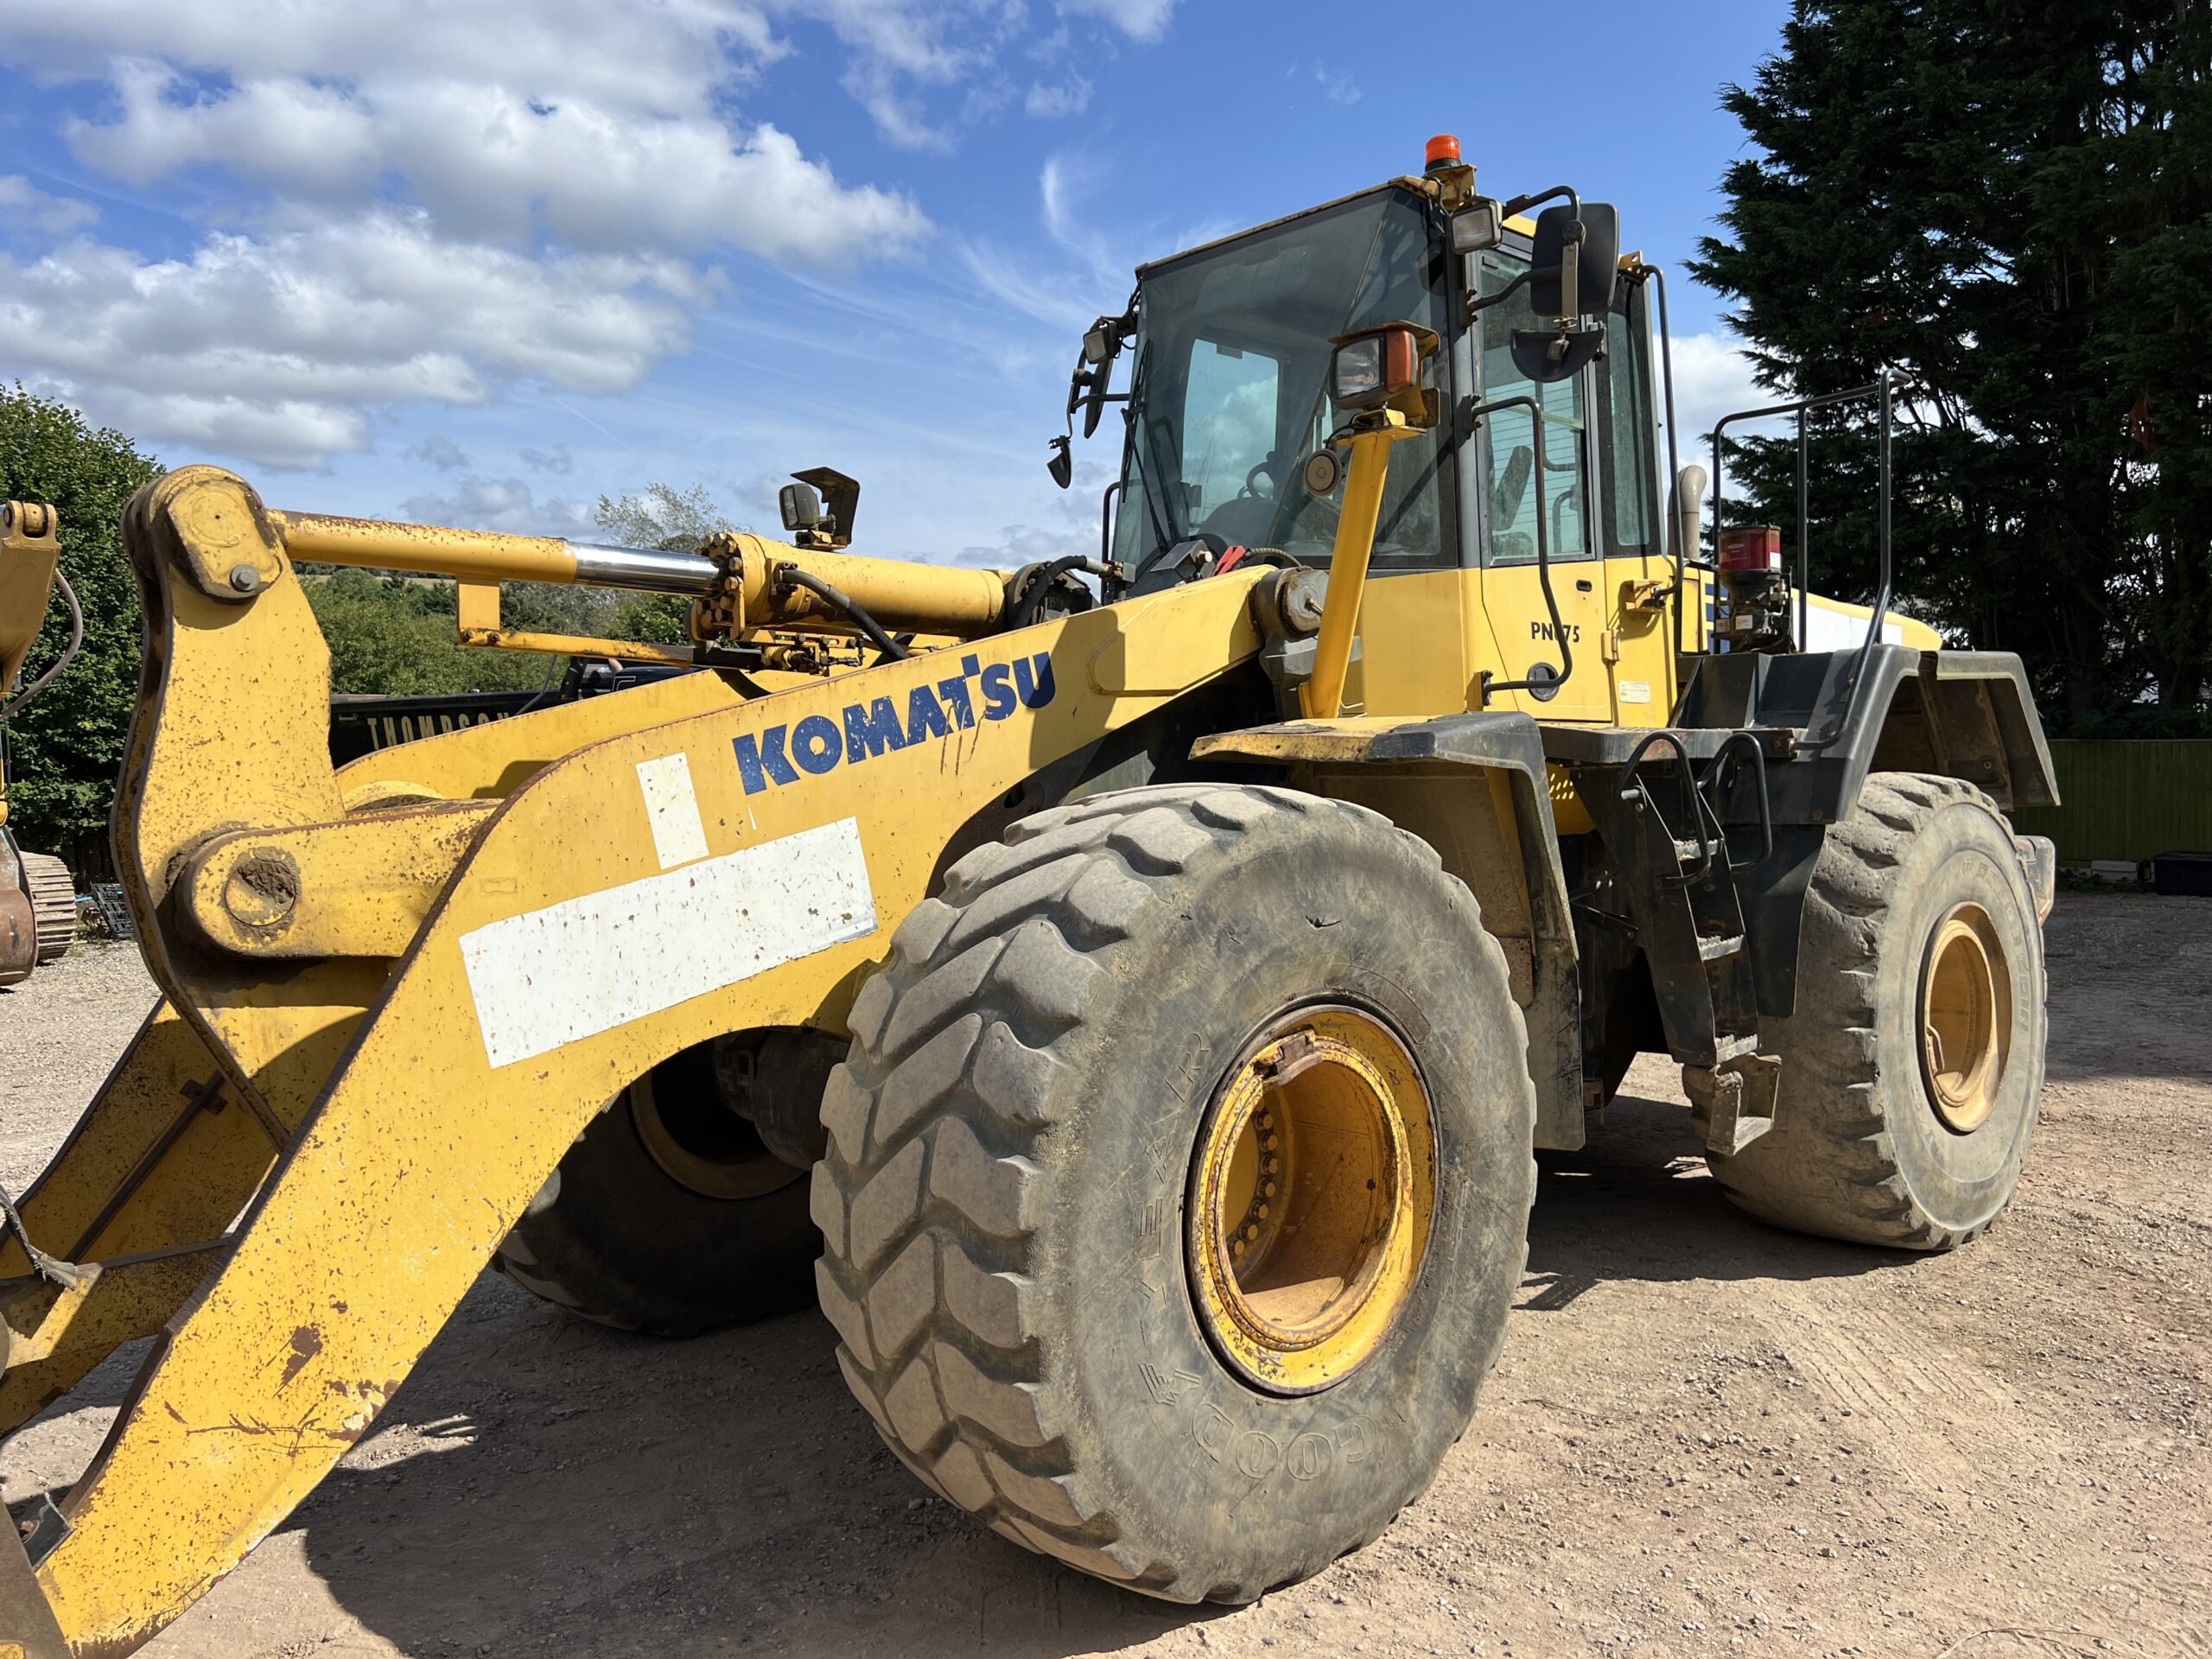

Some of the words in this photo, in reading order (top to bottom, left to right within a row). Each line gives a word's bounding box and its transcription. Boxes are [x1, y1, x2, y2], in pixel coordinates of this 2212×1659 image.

[1530, 621, 1580, 643] PN75
[366, 711, 510, 750] THOMP
[731, 651, 1056, 796] KOMATSU
